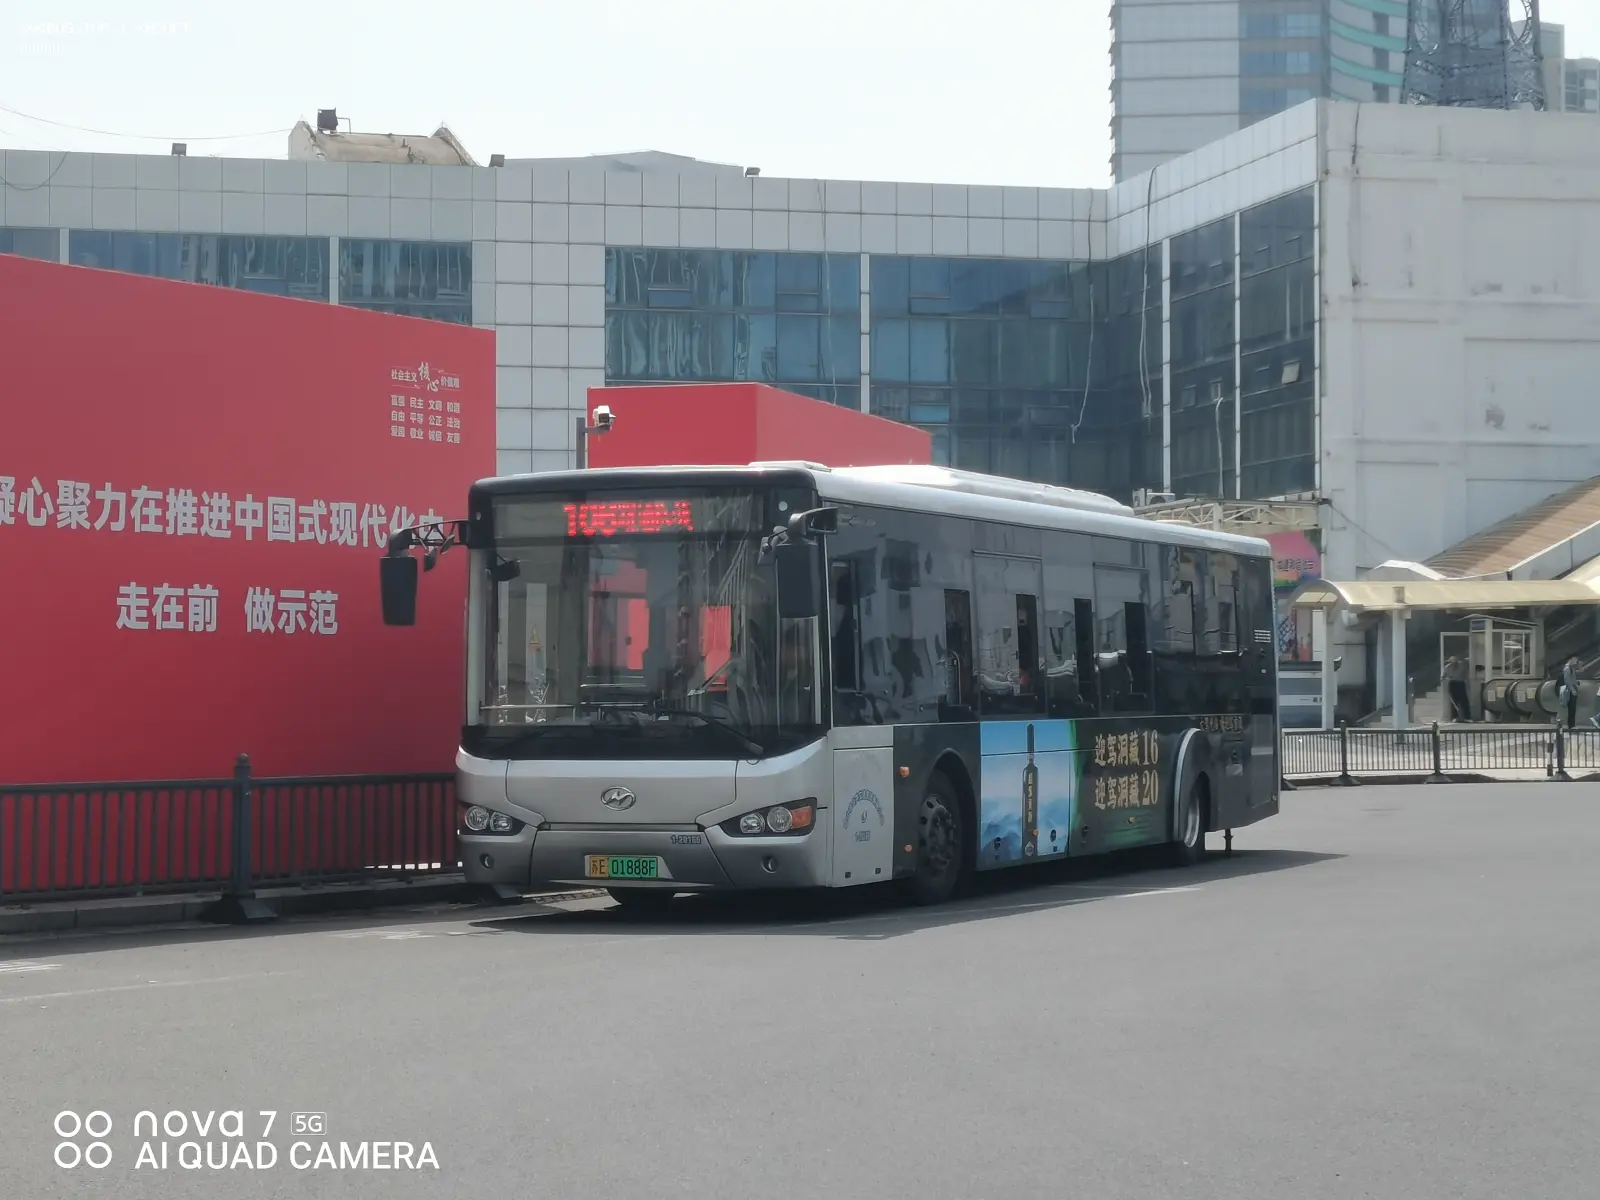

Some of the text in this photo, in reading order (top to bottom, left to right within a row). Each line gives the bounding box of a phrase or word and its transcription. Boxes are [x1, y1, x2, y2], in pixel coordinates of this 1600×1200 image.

[116, 582, 339, 635] 走在前 做示范
